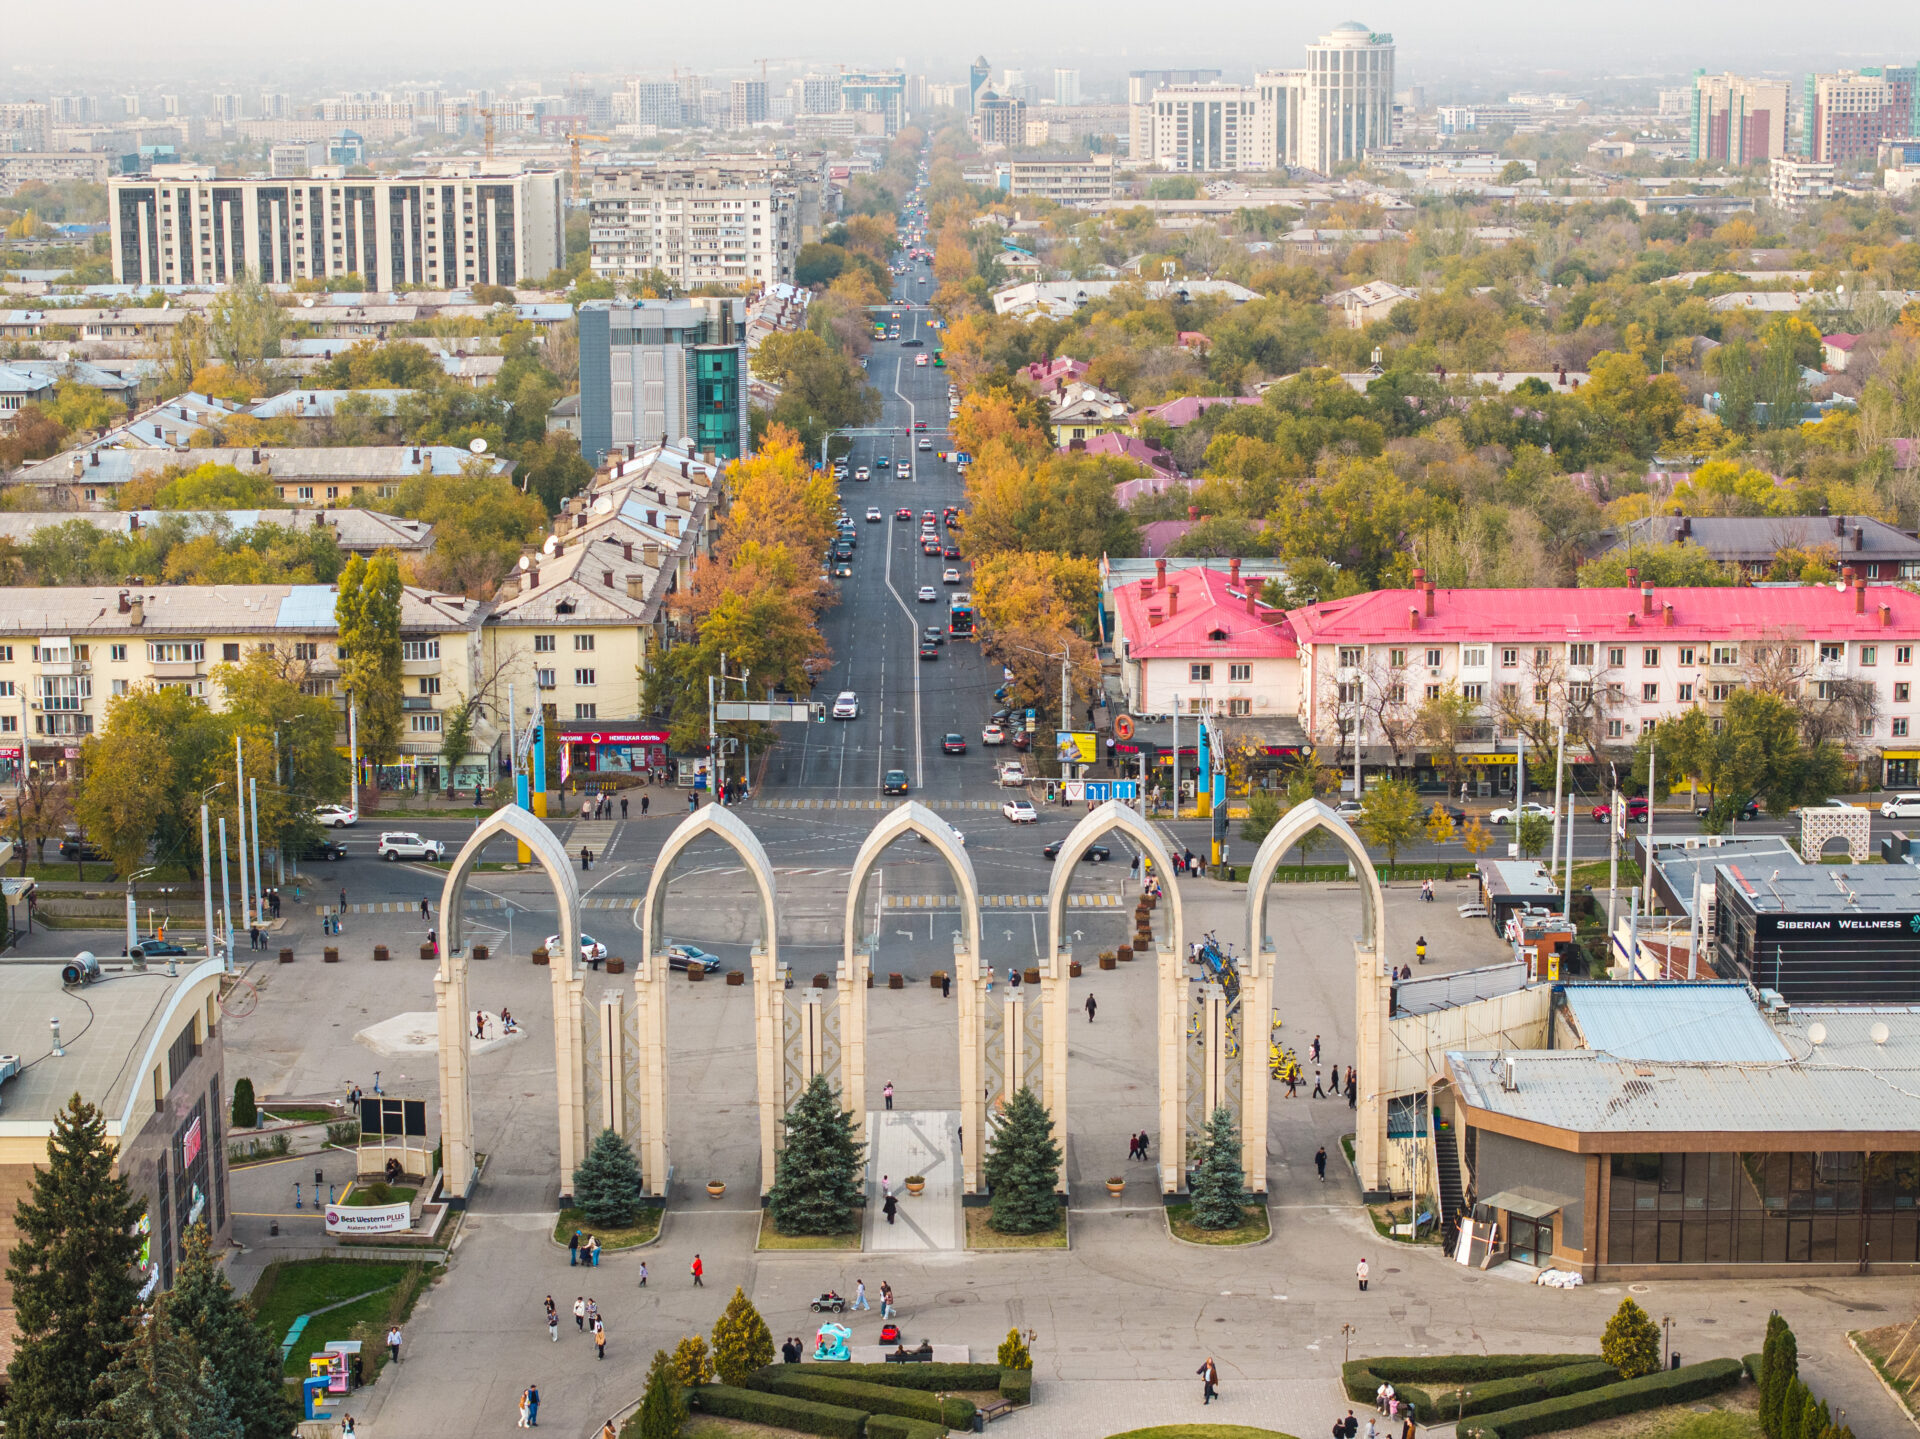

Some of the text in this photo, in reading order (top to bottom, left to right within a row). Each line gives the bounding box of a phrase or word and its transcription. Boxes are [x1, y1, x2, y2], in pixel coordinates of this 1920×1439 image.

[1776, 920, 1902, 929] SIBERIAN WELLNESS
[386, 1213, 405, 1221] PLUS
